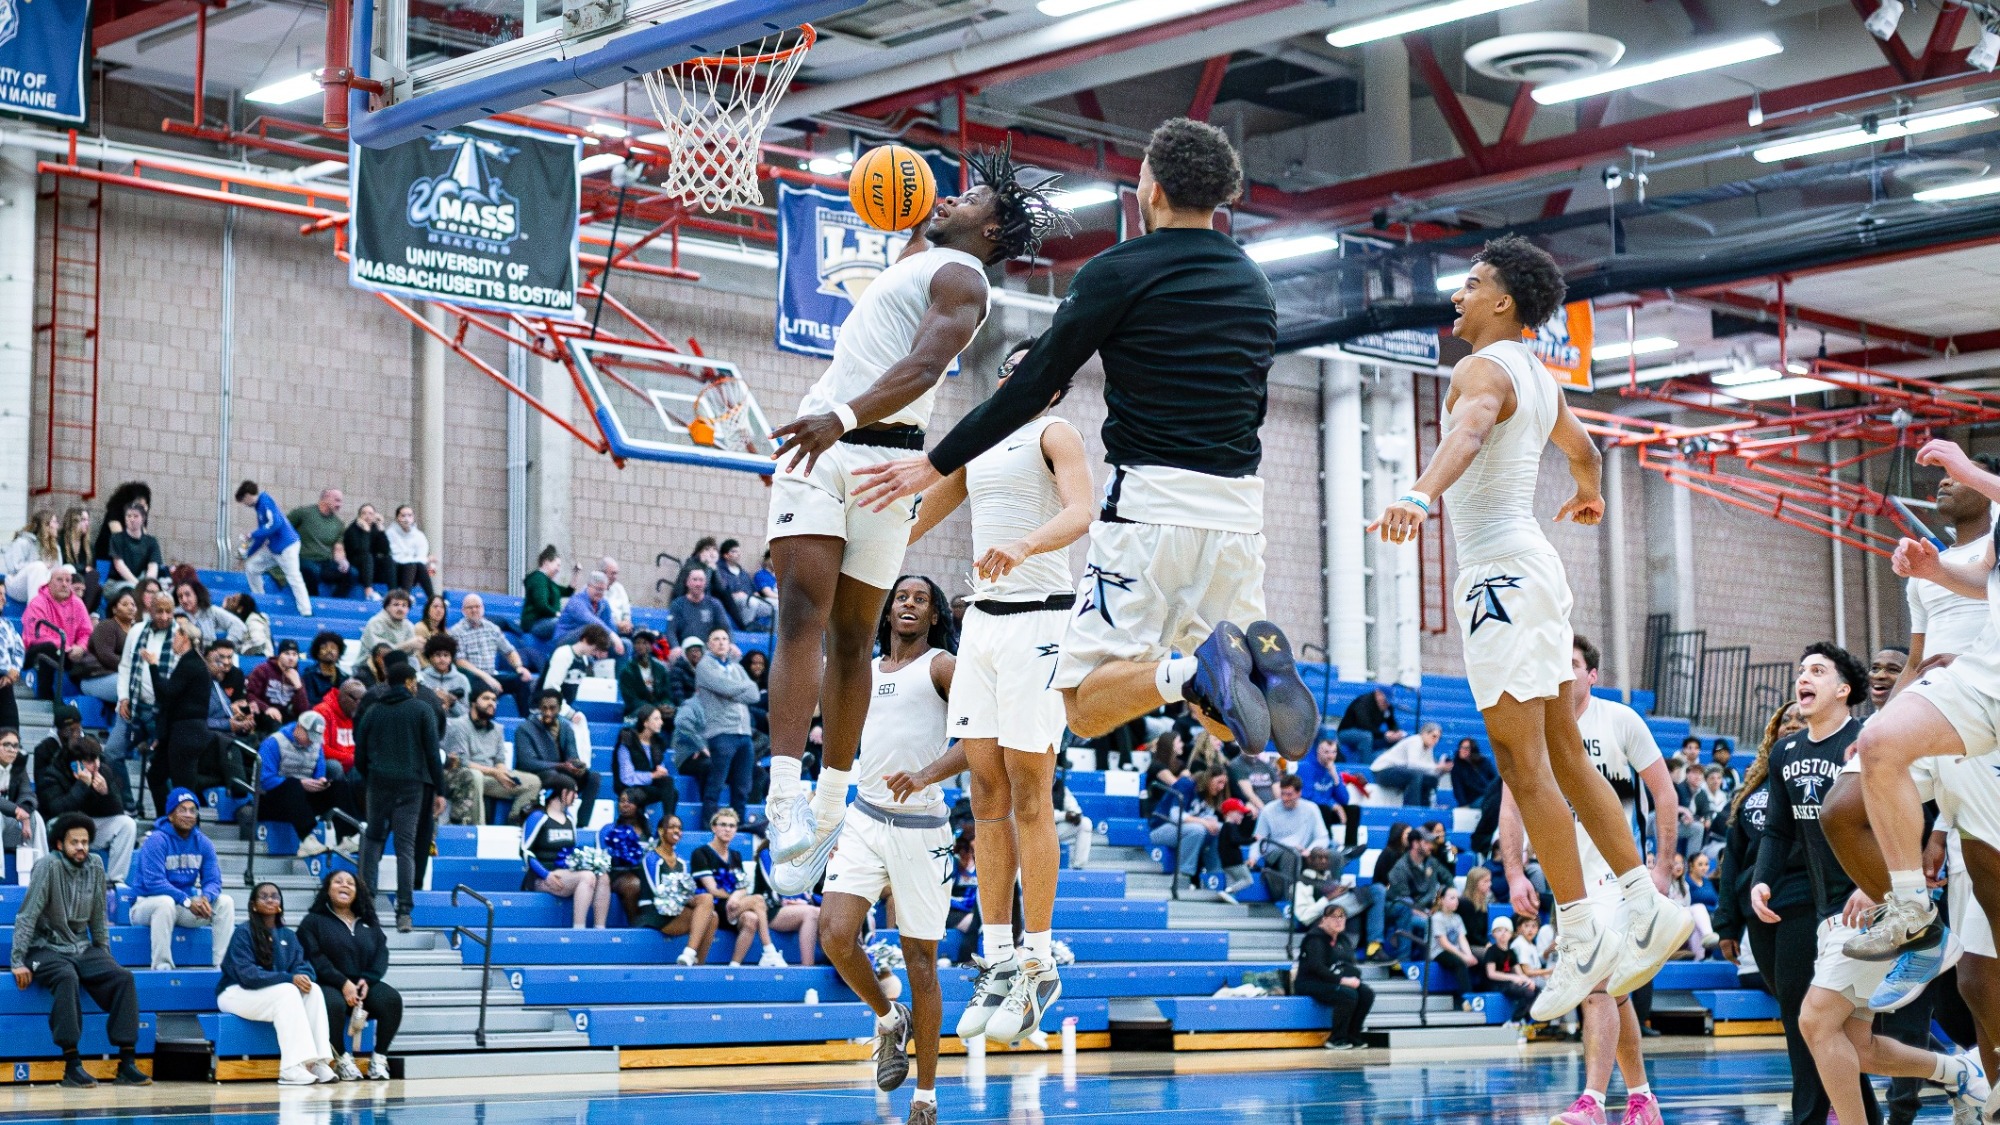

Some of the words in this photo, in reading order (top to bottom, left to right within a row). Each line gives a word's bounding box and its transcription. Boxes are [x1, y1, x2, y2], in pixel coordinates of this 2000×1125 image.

[0, 66, 20, 86] ITY
[23, 71, 47, 90] OF
[9, 86, 57, 109] MAINE
[900, 160, 917, 217] Wilson
[405, 246, 504, 278] UNIVERSITY
[507, 262, 529, 282] OF
[356, 258, 506, 300] MASSACHUSETTS
[508, 285, 572, 308] BOSTON
[784, 316, 831, 340] LITTLE
[1782, 758, 1842, 784] BOSTON
